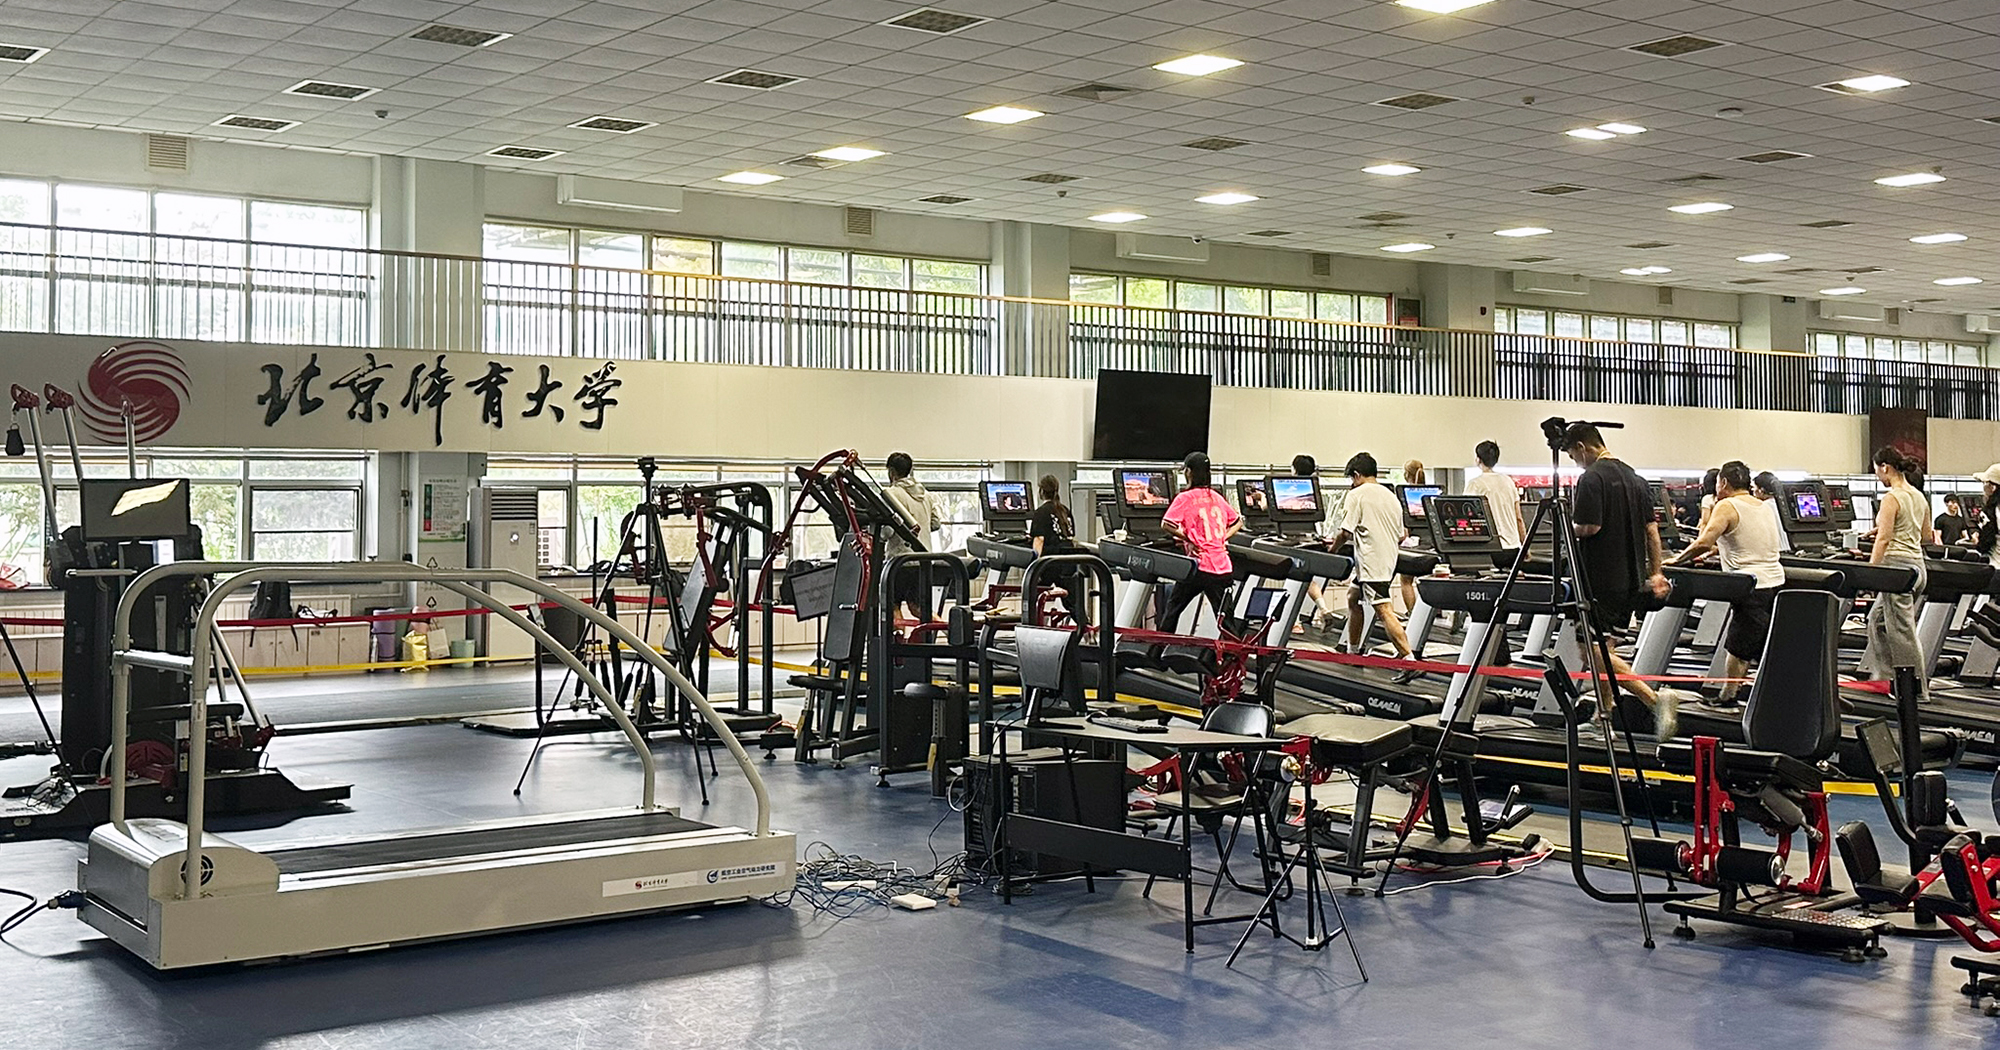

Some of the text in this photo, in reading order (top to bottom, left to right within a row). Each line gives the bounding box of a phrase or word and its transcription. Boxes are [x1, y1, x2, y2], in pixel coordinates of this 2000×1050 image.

[257, 352, 623, 447] 北京体育大学
[1198, 505, 1225, 541] 13
